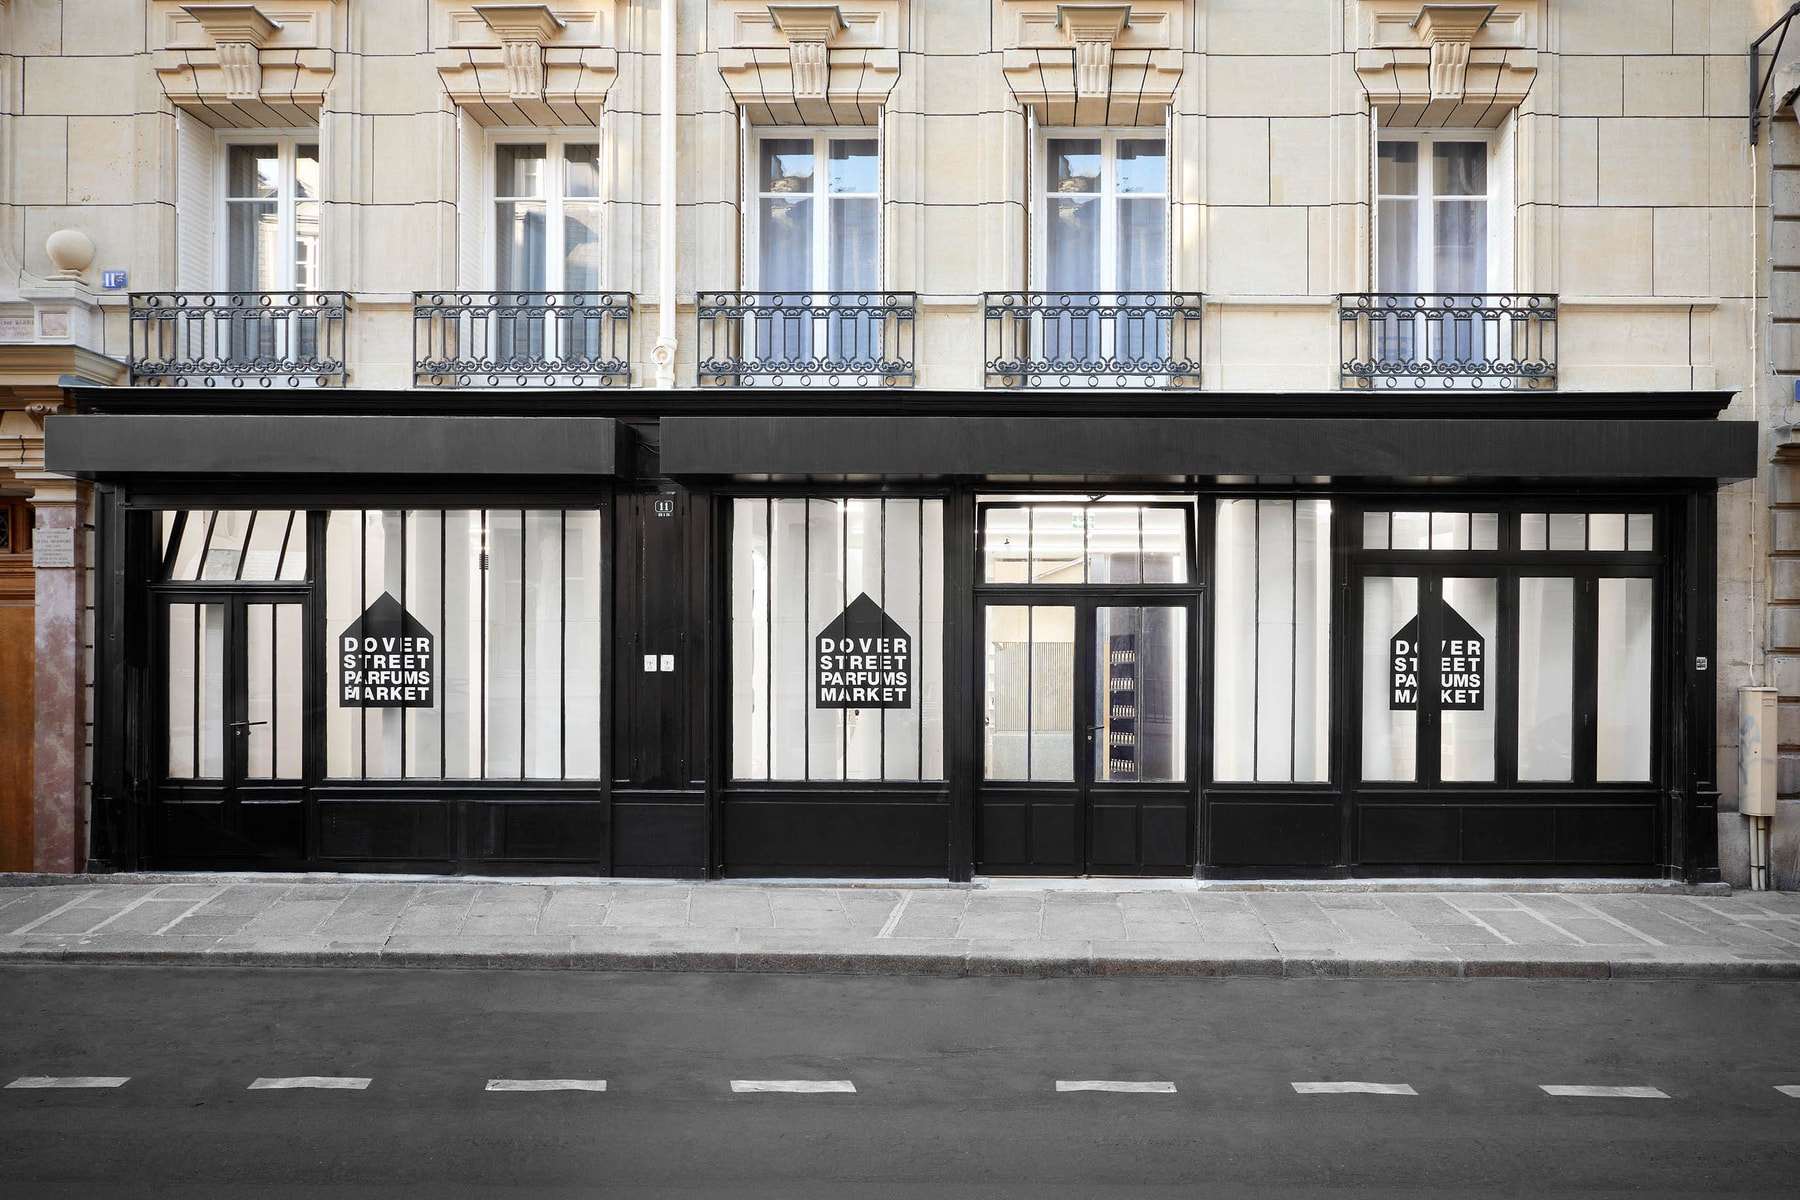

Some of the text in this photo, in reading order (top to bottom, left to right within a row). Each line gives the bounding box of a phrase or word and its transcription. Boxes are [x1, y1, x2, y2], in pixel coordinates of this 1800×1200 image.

[659, 502, 668, 511] 11
[344, 637, 430, 653] DOVER
[820, 638, 907, 653] DOVER
[1395, 640, 1481, 655] DER
[343, 654, 430, 669] STREET
[820, 655, 907, 670] STREET
[1394, 657, 1480, 672] STEET
[344, 670, 430, 685] PARFUMS
[820, 671, 908, 686] PARFUMS
[1395, 673, 1481, 688] PAUMS
[344, 686, 430, 701] MARKET
[820, 687, 907, 702] MARKET
[1395, 690, 1480, 704] MKET
